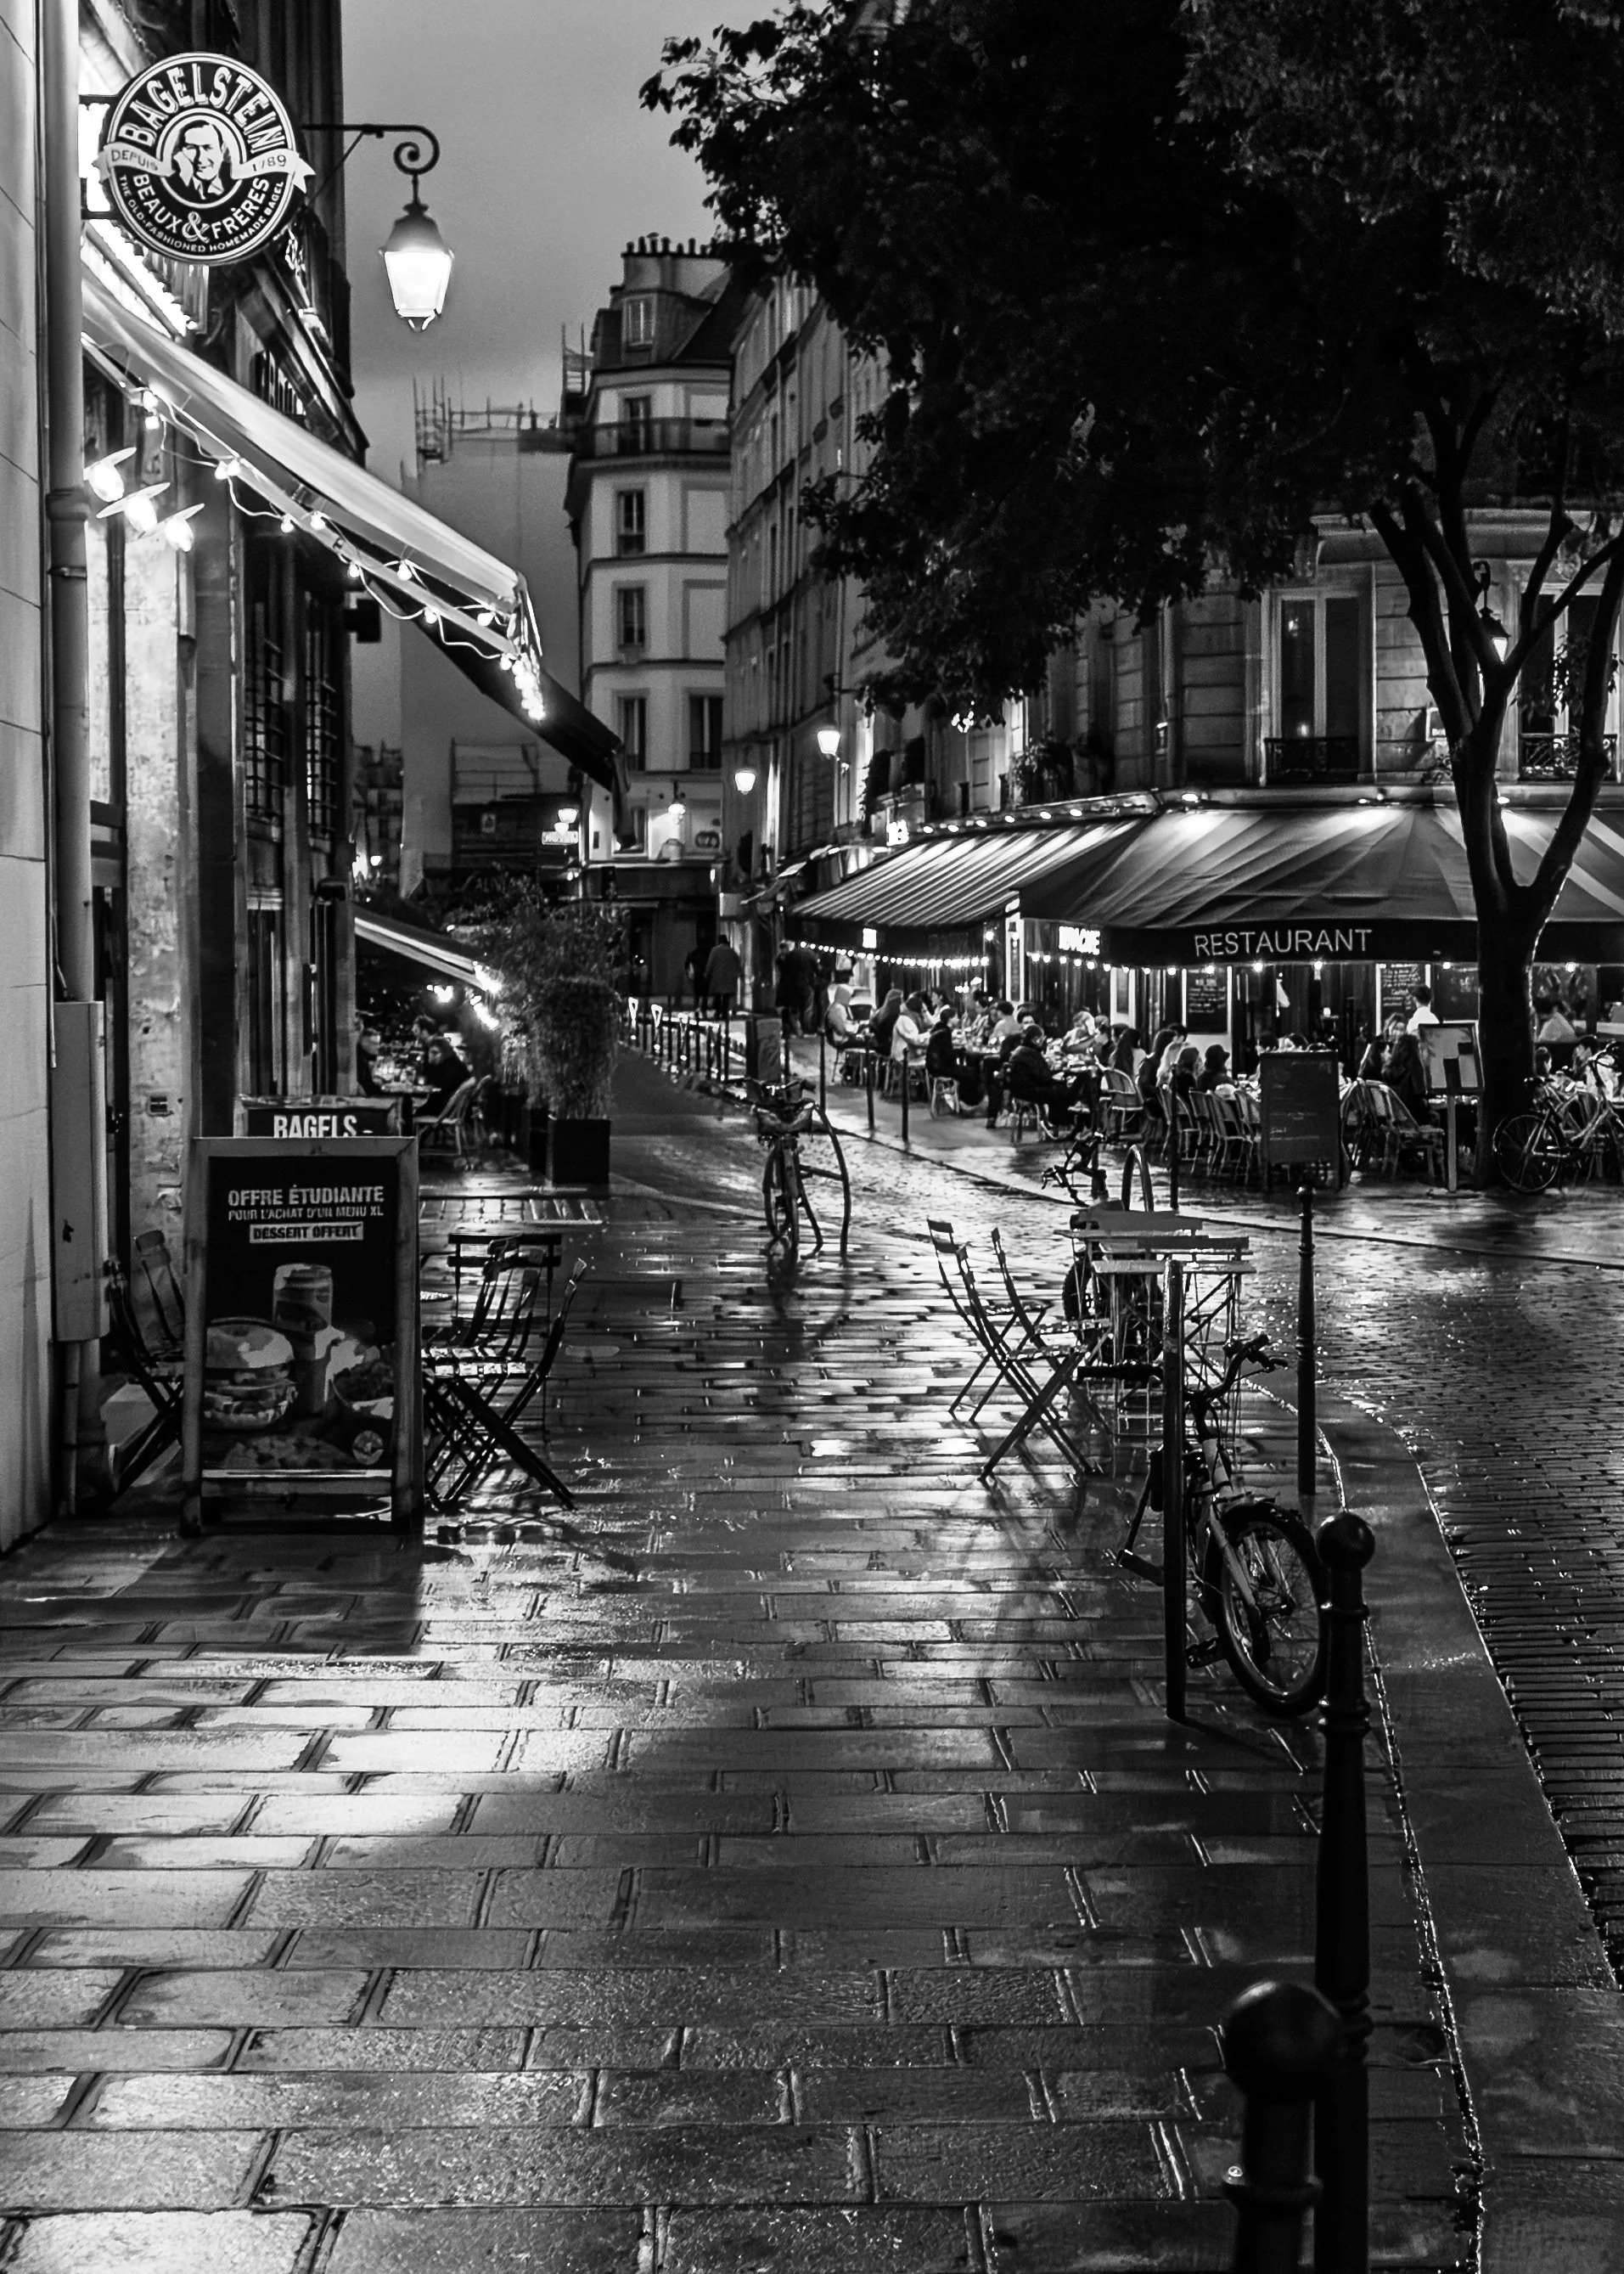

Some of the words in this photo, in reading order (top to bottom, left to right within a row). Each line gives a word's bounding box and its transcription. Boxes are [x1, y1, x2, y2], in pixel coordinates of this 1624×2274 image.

[118, 63, 286, 155] BAGELSTEIN
[111, 149, 159, 172] DEPUIS
[252, 155, 287, 172] 1789
[120, 174, 132, 197] THE
[209, 216, 267, 252] HOMEMADE
[264, 181, 284, 216] BAGEL
[132, 174, 183, 234] BEAUX
[182, 211, 211, 244] &
[211, 177, 269, 239] FRÈRES
[1194, 929, 1373, 957] RESTAURANT
[273, 1115, 357, 1138] BAGELS
[228, 1189, 283, 1207] OFFRE
[289, 1185, 385, 1205] ÉTUDIANTE
[228, 1208, 257, 1220] POUR
[261, 1207, 304, 1219] L'ACHAT
[306, 1207, 333, 1219] D'UN
[335, 1206, 368, 1218] MENU
[370, 1205, 385, 1217] XL
[253, 1225, 308, 1240] DESSERT
[312, 1224, 358, 1239] OFFERT
